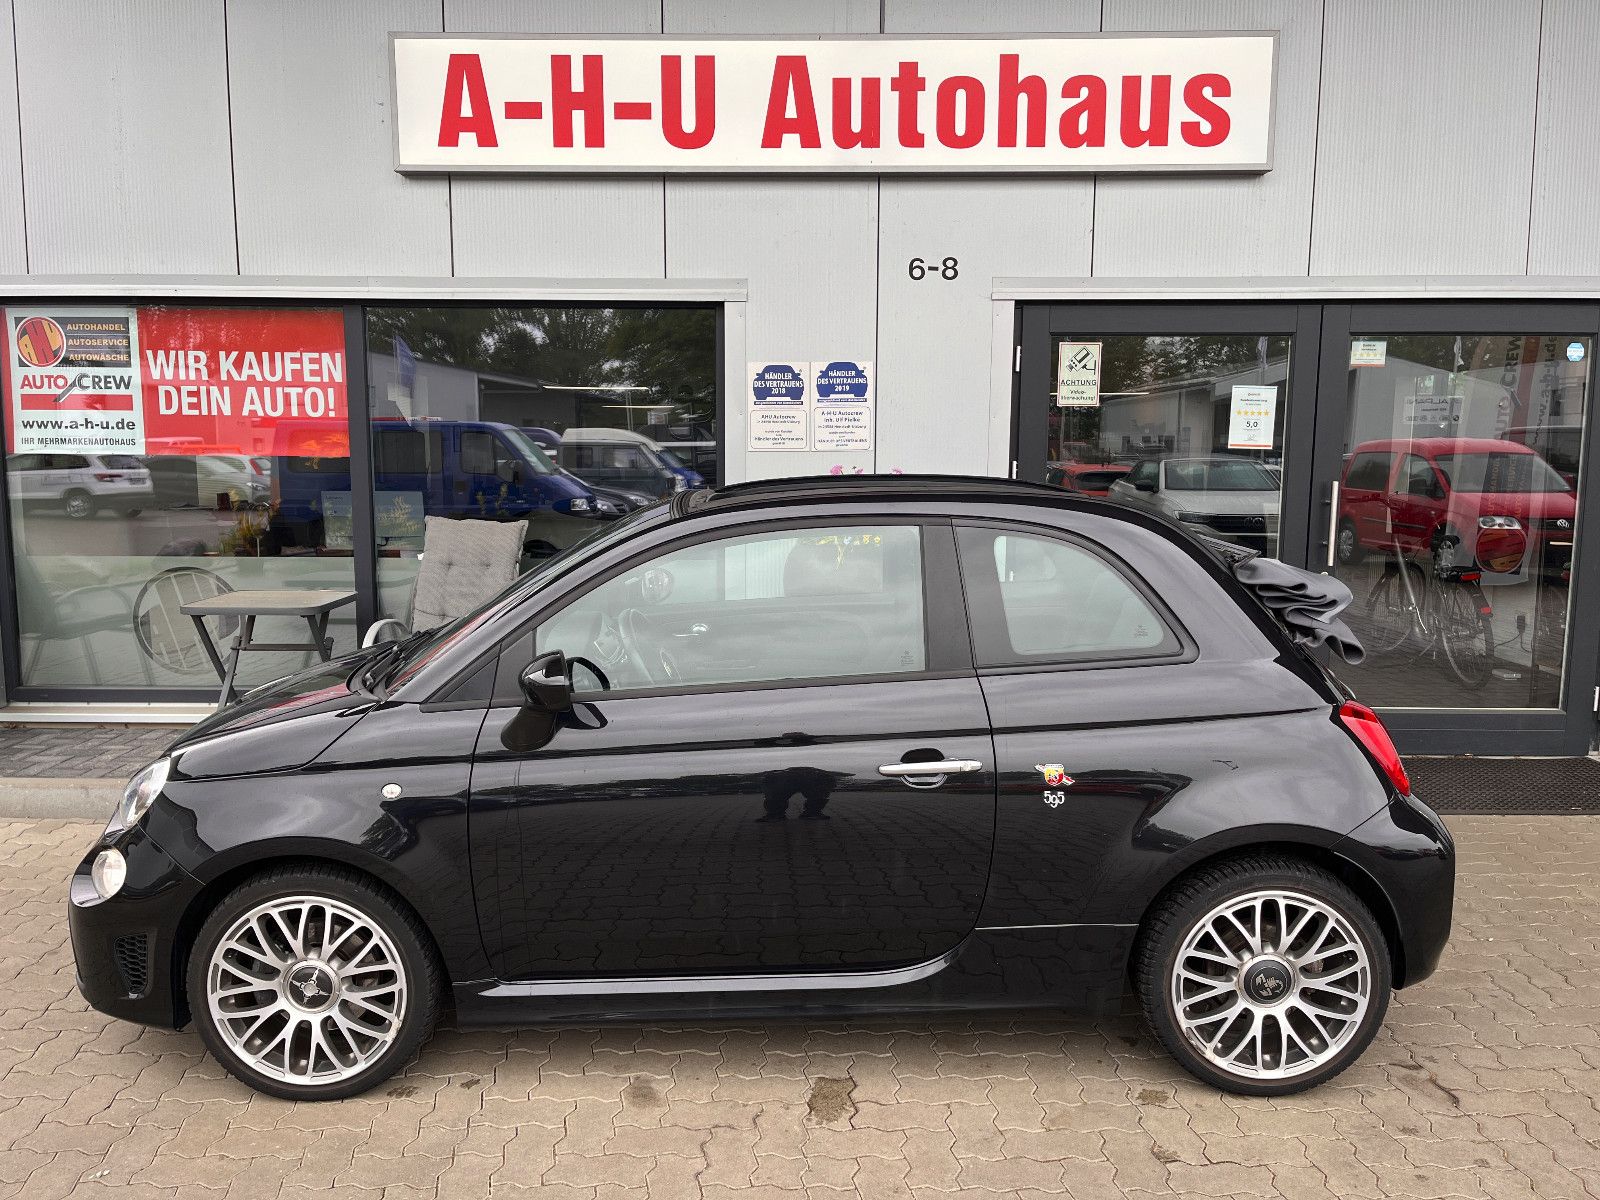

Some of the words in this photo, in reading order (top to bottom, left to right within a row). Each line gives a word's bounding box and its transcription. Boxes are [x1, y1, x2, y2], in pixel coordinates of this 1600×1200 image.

[438, 54, 716, 149] A-H-U
[761, 54, 1232, 149] Autohaus
[908, 256, 959, 281] 6-8
[66, 323, 126, 331] AUTOHANDEL
[68, 338, 129, 346] AUTOSERVICE
[69, 353, 130, 361] AUTOWÄSCHE
[146, 350, 209, 381] WIR
[219, 351, 343, 383] KAUFEN
[764, 372, 793, 380] HÄNDLER
[828, 369, 856, 377] HÄNDLER
[754, 380, 766, 388] DES
[765, 380, 804, 388] VERTRAUENS
[828, 377, 867, 385] VERTRAUENS
[771, 387, 786, 395] 2018
[158, 386, 232, 416] DEIN
[242, 387, 336, 418] AUTO!
[21, 418, 136, 430] www.a-h-u.de
[1246, 420, 1259, 429] 5,0
[21, 437, 35, 445] IHR
[37, 437, 136, 446] MEHRMARKENAUTOHAUS
[1043, 790, 1065, 809] 595
